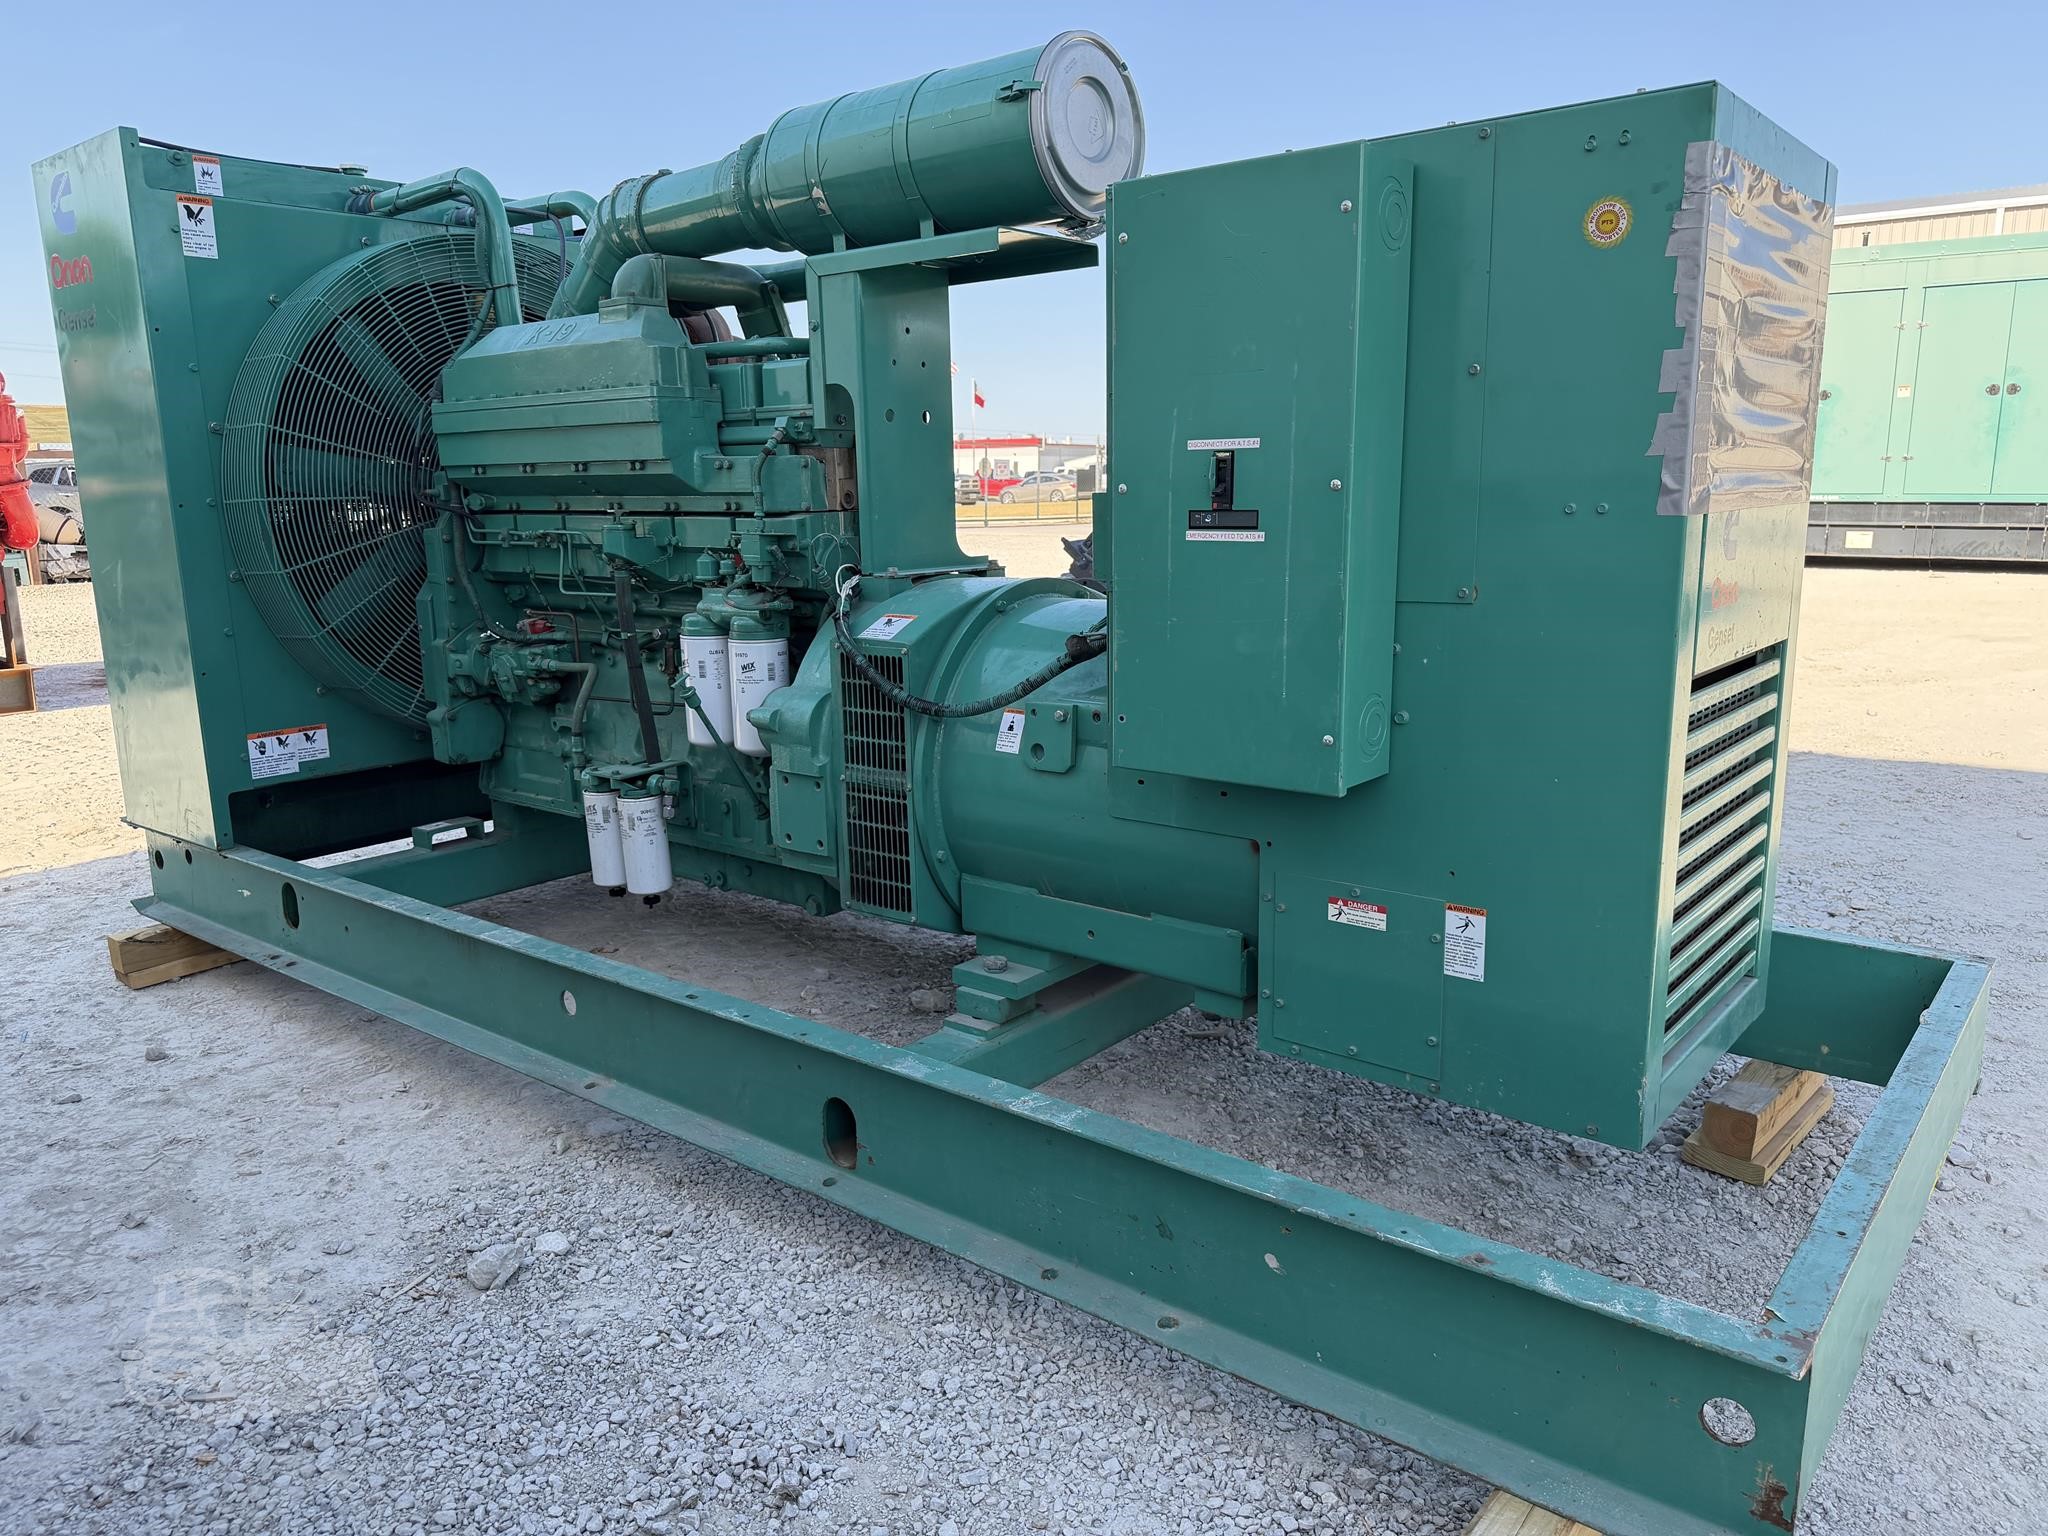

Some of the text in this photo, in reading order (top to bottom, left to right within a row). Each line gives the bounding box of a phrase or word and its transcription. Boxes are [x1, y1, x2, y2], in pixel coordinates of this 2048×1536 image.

[1589, 203, 1626, 223] PROTOTYPE TEST
[1591, 227, 1622, 241] SUPPORTED
[50, 253, 94, 289] Onan
[525, 322, 577, 345] K-19
[1188, 440, 1223, 449] DISCONNECT
[741, 661, 756, 671] WIX
[1347, 900, 1378, 912] DANGER
[1453, 904, 1485, 916] WARNING
